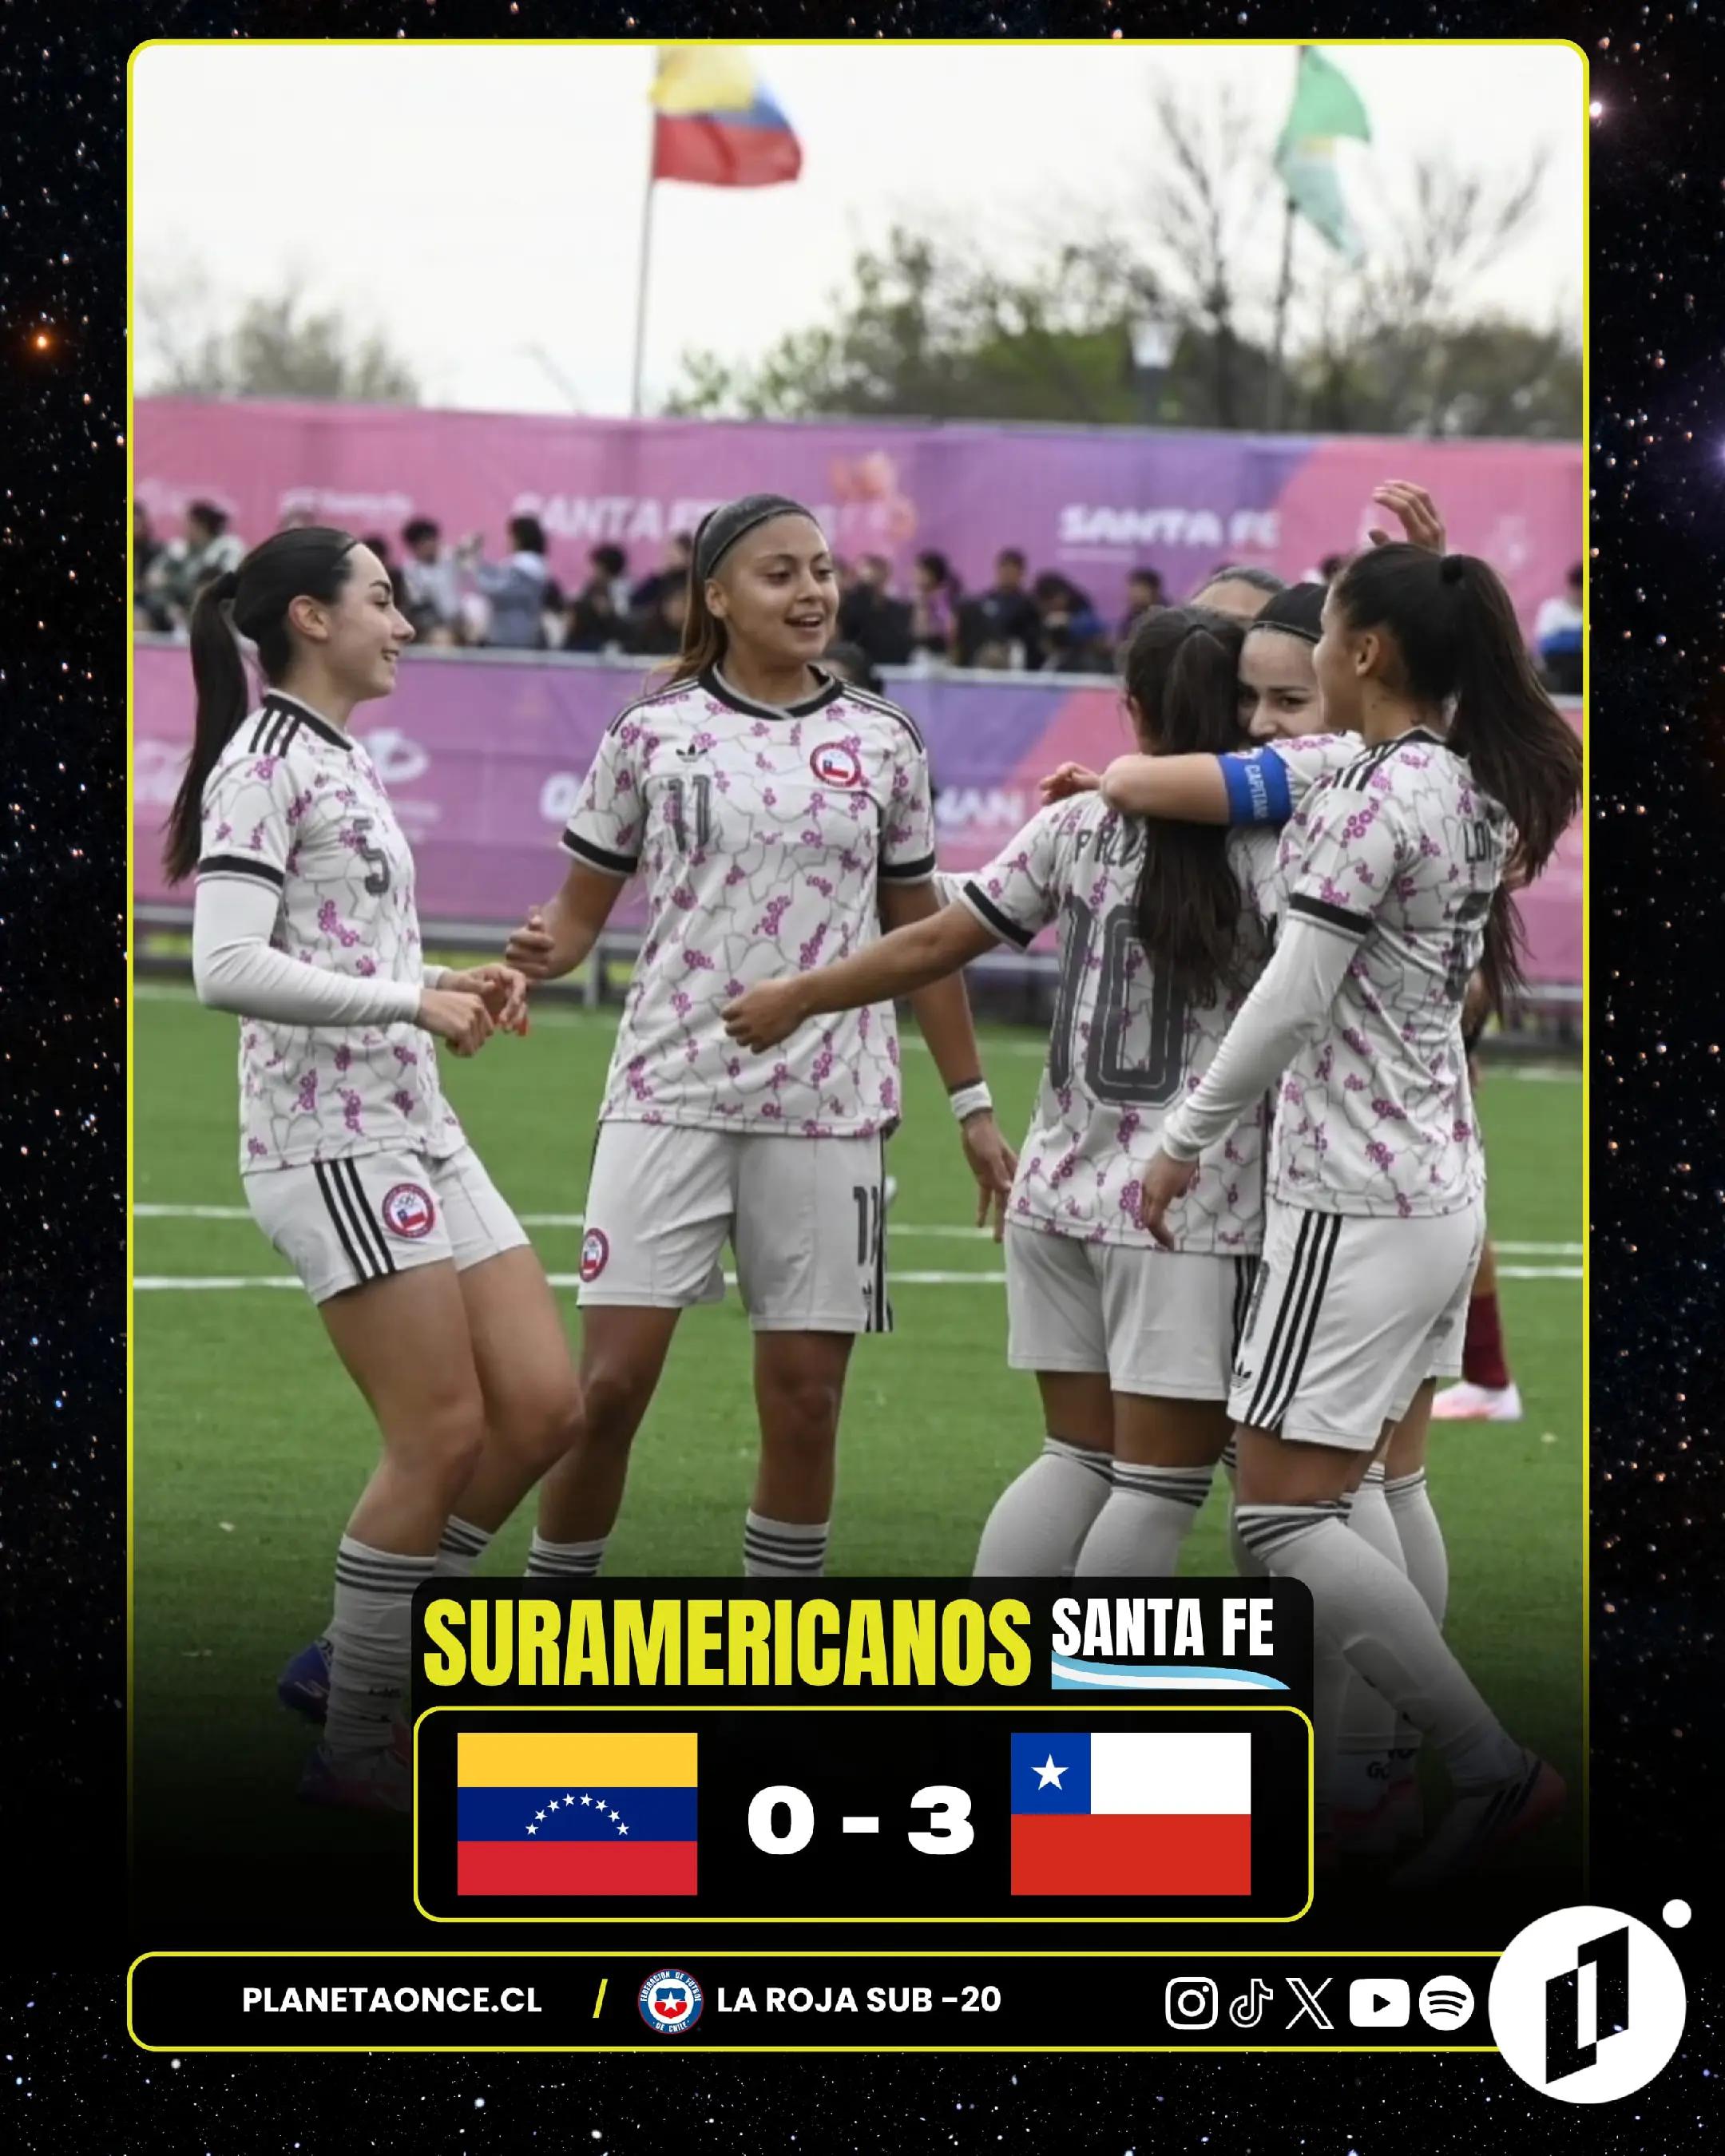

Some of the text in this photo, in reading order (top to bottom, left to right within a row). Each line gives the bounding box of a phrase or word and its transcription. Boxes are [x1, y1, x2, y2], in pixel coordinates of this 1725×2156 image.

[1061, 504, 1223, 545] SANTA
[667, 774, 712, 853] 11
[352, 817, 391, 896] 5
[1049, 894, 1188, 1110] 10
